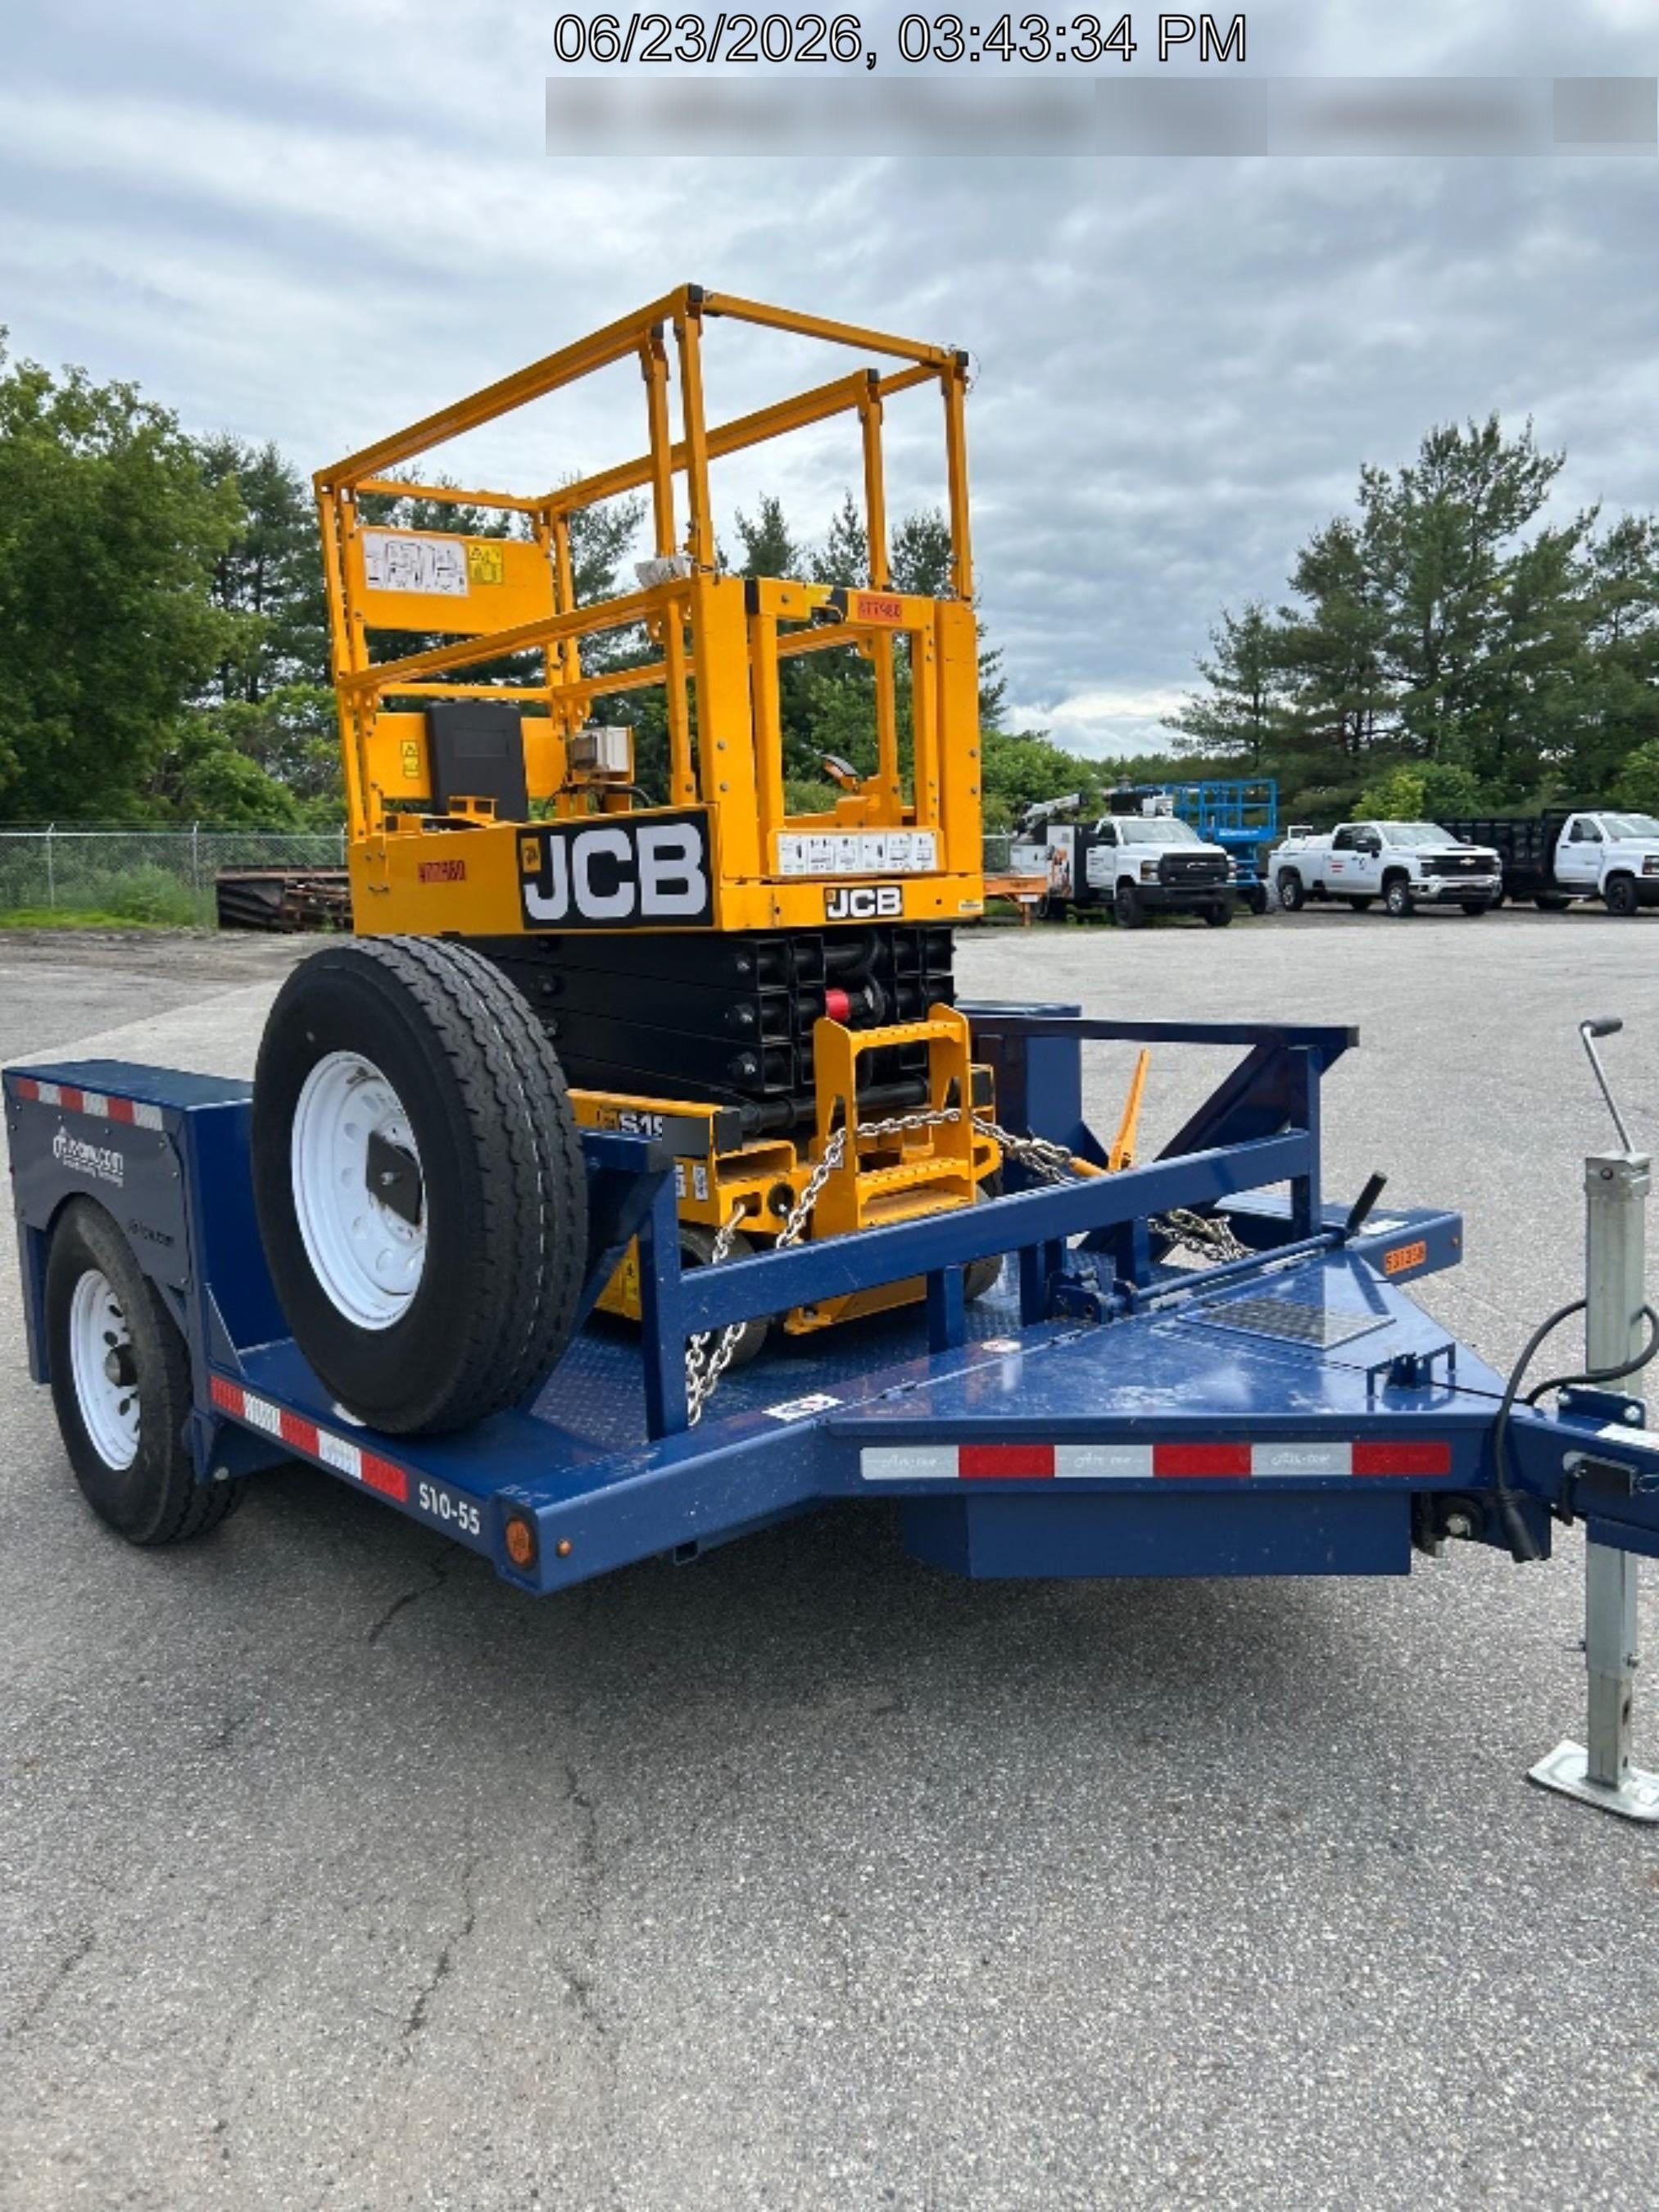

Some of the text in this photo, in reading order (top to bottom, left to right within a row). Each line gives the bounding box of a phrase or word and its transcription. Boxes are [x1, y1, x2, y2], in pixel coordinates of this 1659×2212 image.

[524, 823, 707, 920] JCB
[827, 886, 902, 918] JCB
[419, 1480, 480, 1535] S10-55
